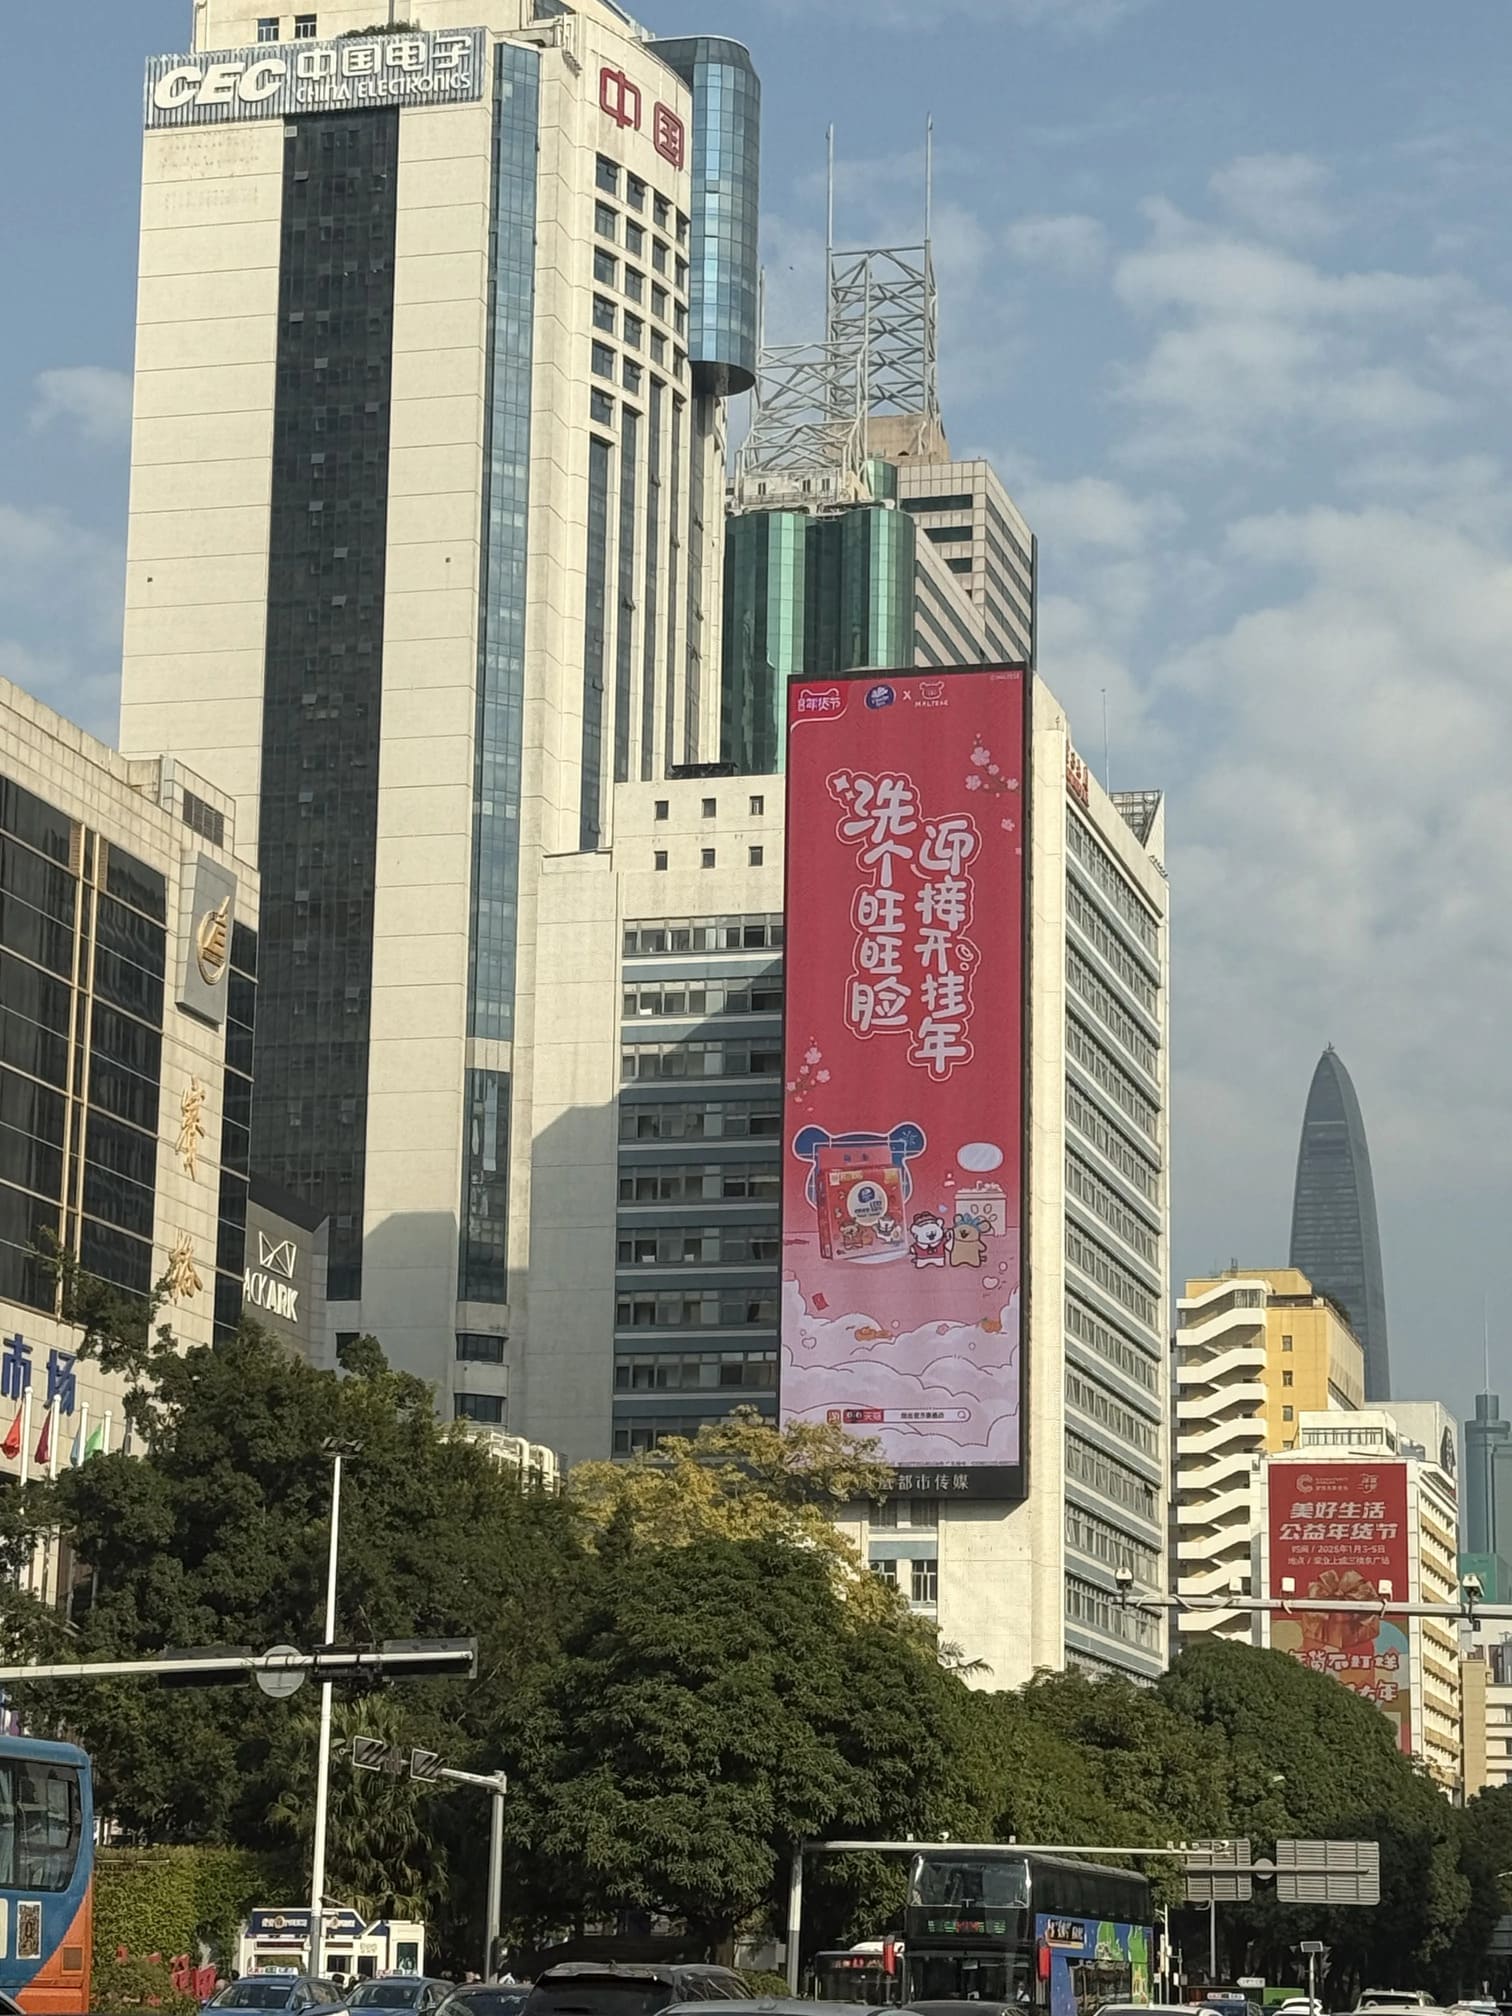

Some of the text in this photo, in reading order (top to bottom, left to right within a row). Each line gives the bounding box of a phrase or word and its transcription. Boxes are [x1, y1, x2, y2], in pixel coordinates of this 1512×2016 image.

[296, 35, 472, 81] 中国电子
[153, 58, 287, 110] CEC
[296, 71, 471, 104] CHINA ELECTRONICS
[600, 66, 685, 171] 中国
[914, 699, 949, 708] MALTESE
[843, 777, 918, 1032] 洗个旺旺脸
[913, 819, 976, 1075] 迎接开挂年
[1, 1333, 77, 1417] 市场
[1279, 1523, 1399, 1541] 公益年货节
[1289, 1501, 1387, 1520] 美好生活
